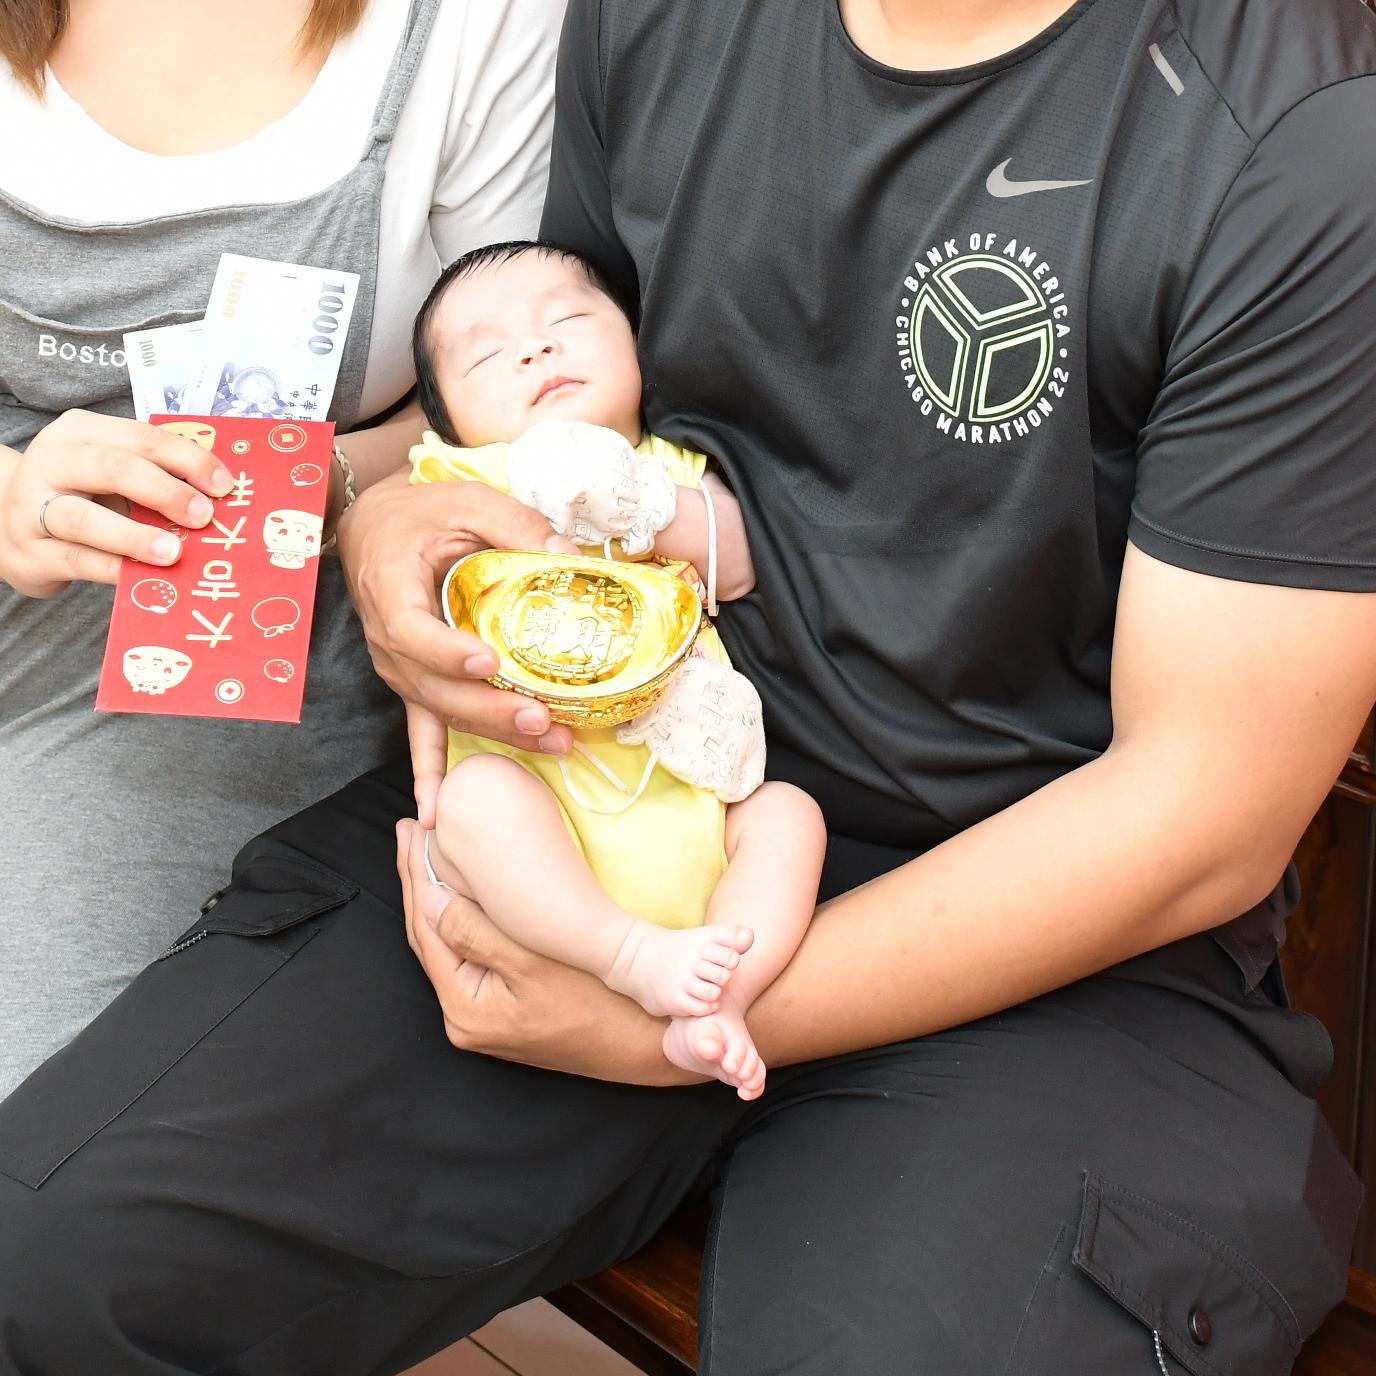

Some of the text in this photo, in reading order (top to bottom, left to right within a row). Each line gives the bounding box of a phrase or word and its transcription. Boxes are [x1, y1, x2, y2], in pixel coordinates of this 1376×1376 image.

[307, 280, 346, 355] 1000
[904, 233, 1070, 338] BANK OF AMERICA
[38, 335, 127, 367] Bosto
[138, 340, 157, 367] 1000
[896, 315, 1069, 444] CHICAGO MARATHON 22
